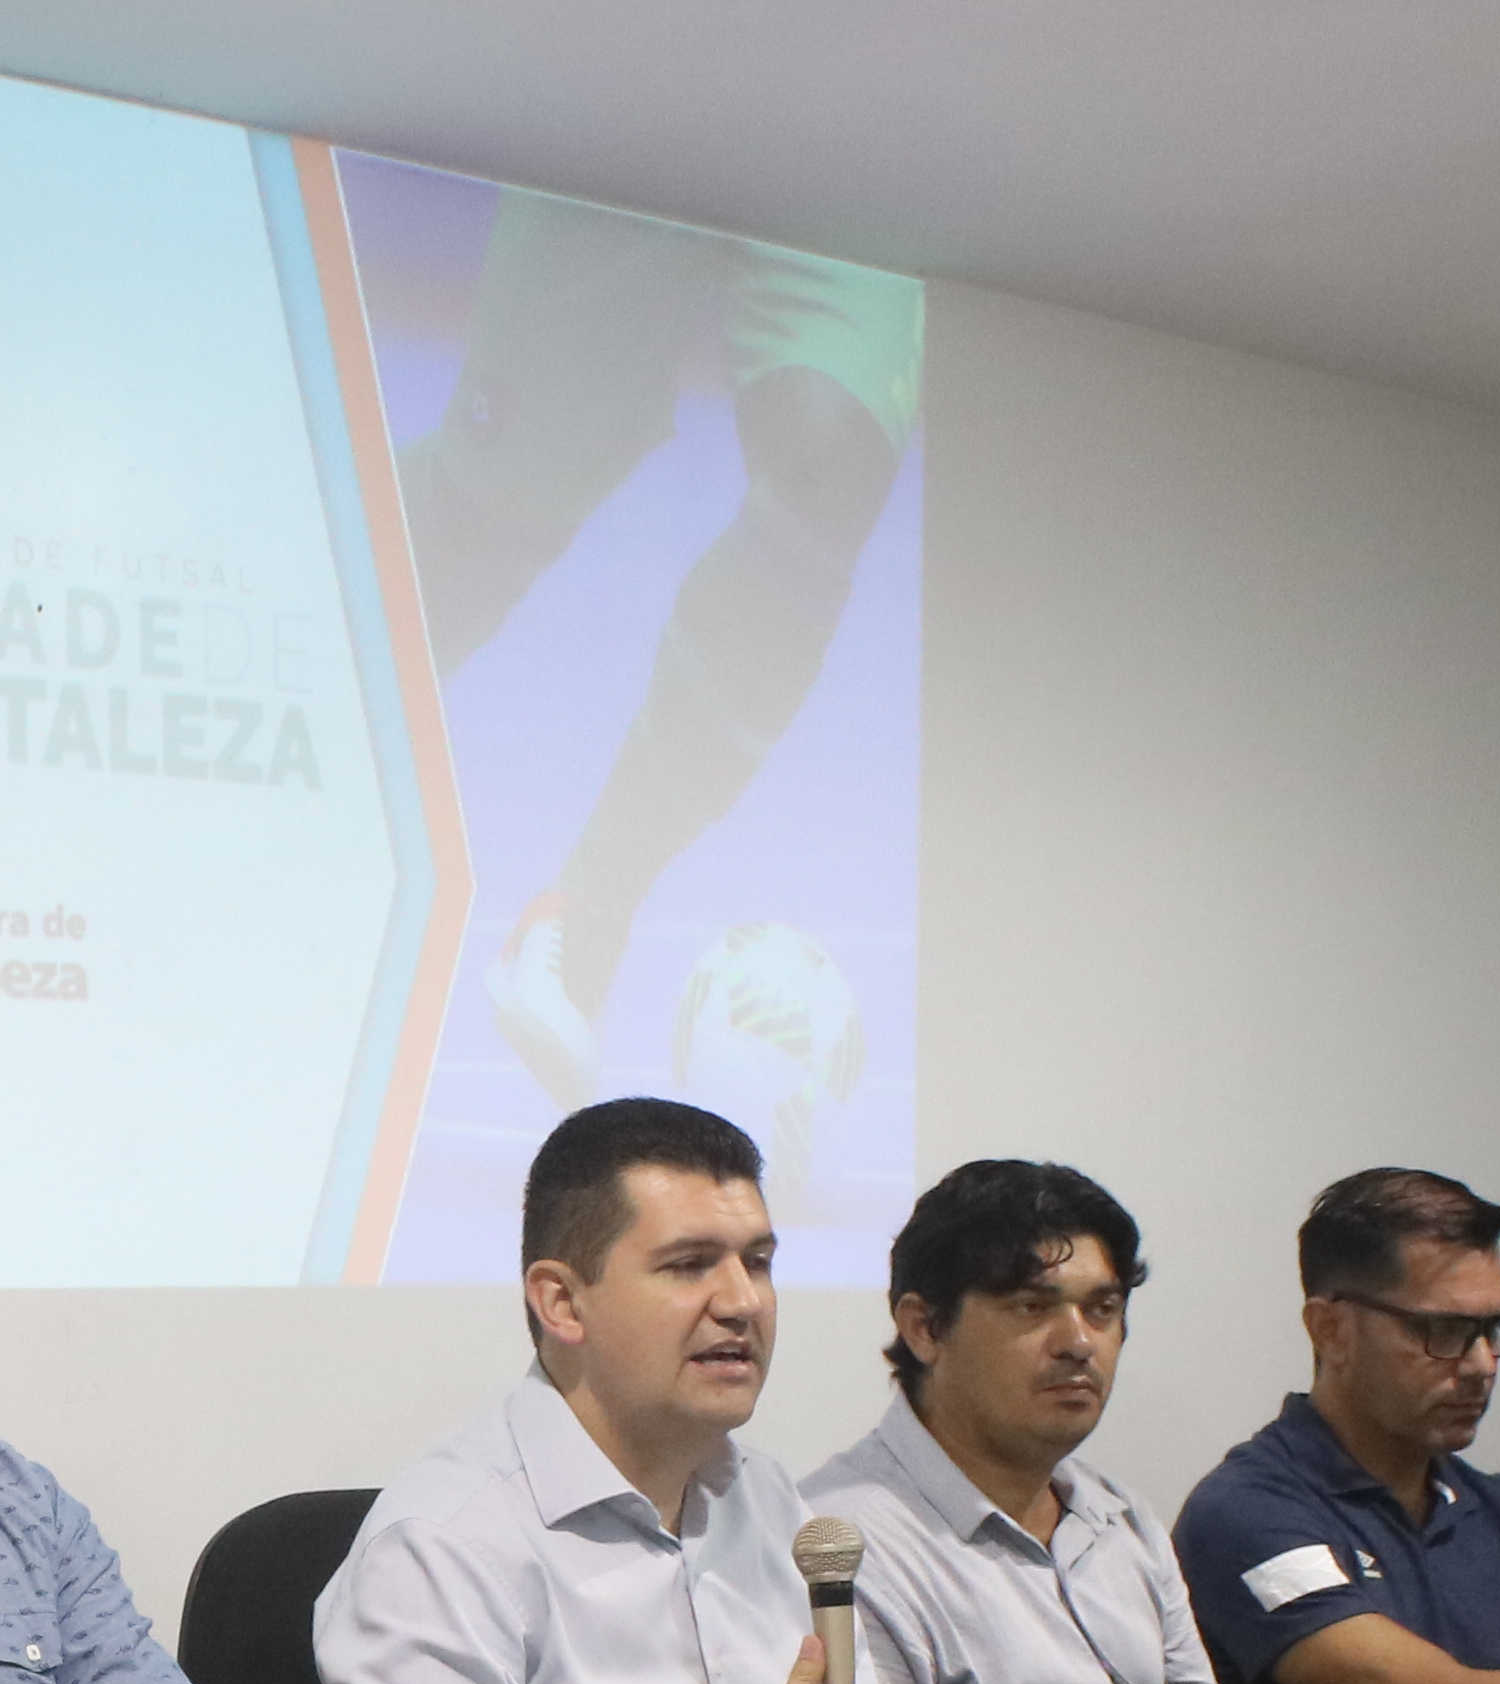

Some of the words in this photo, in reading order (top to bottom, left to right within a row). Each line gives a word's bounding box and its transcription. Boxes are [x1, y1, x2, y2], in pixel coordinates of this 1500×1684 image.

[13, 536, 64, 571] DE
[93, 545, 256, 594] FUTSAL
[43, 905, 88, 940] de
